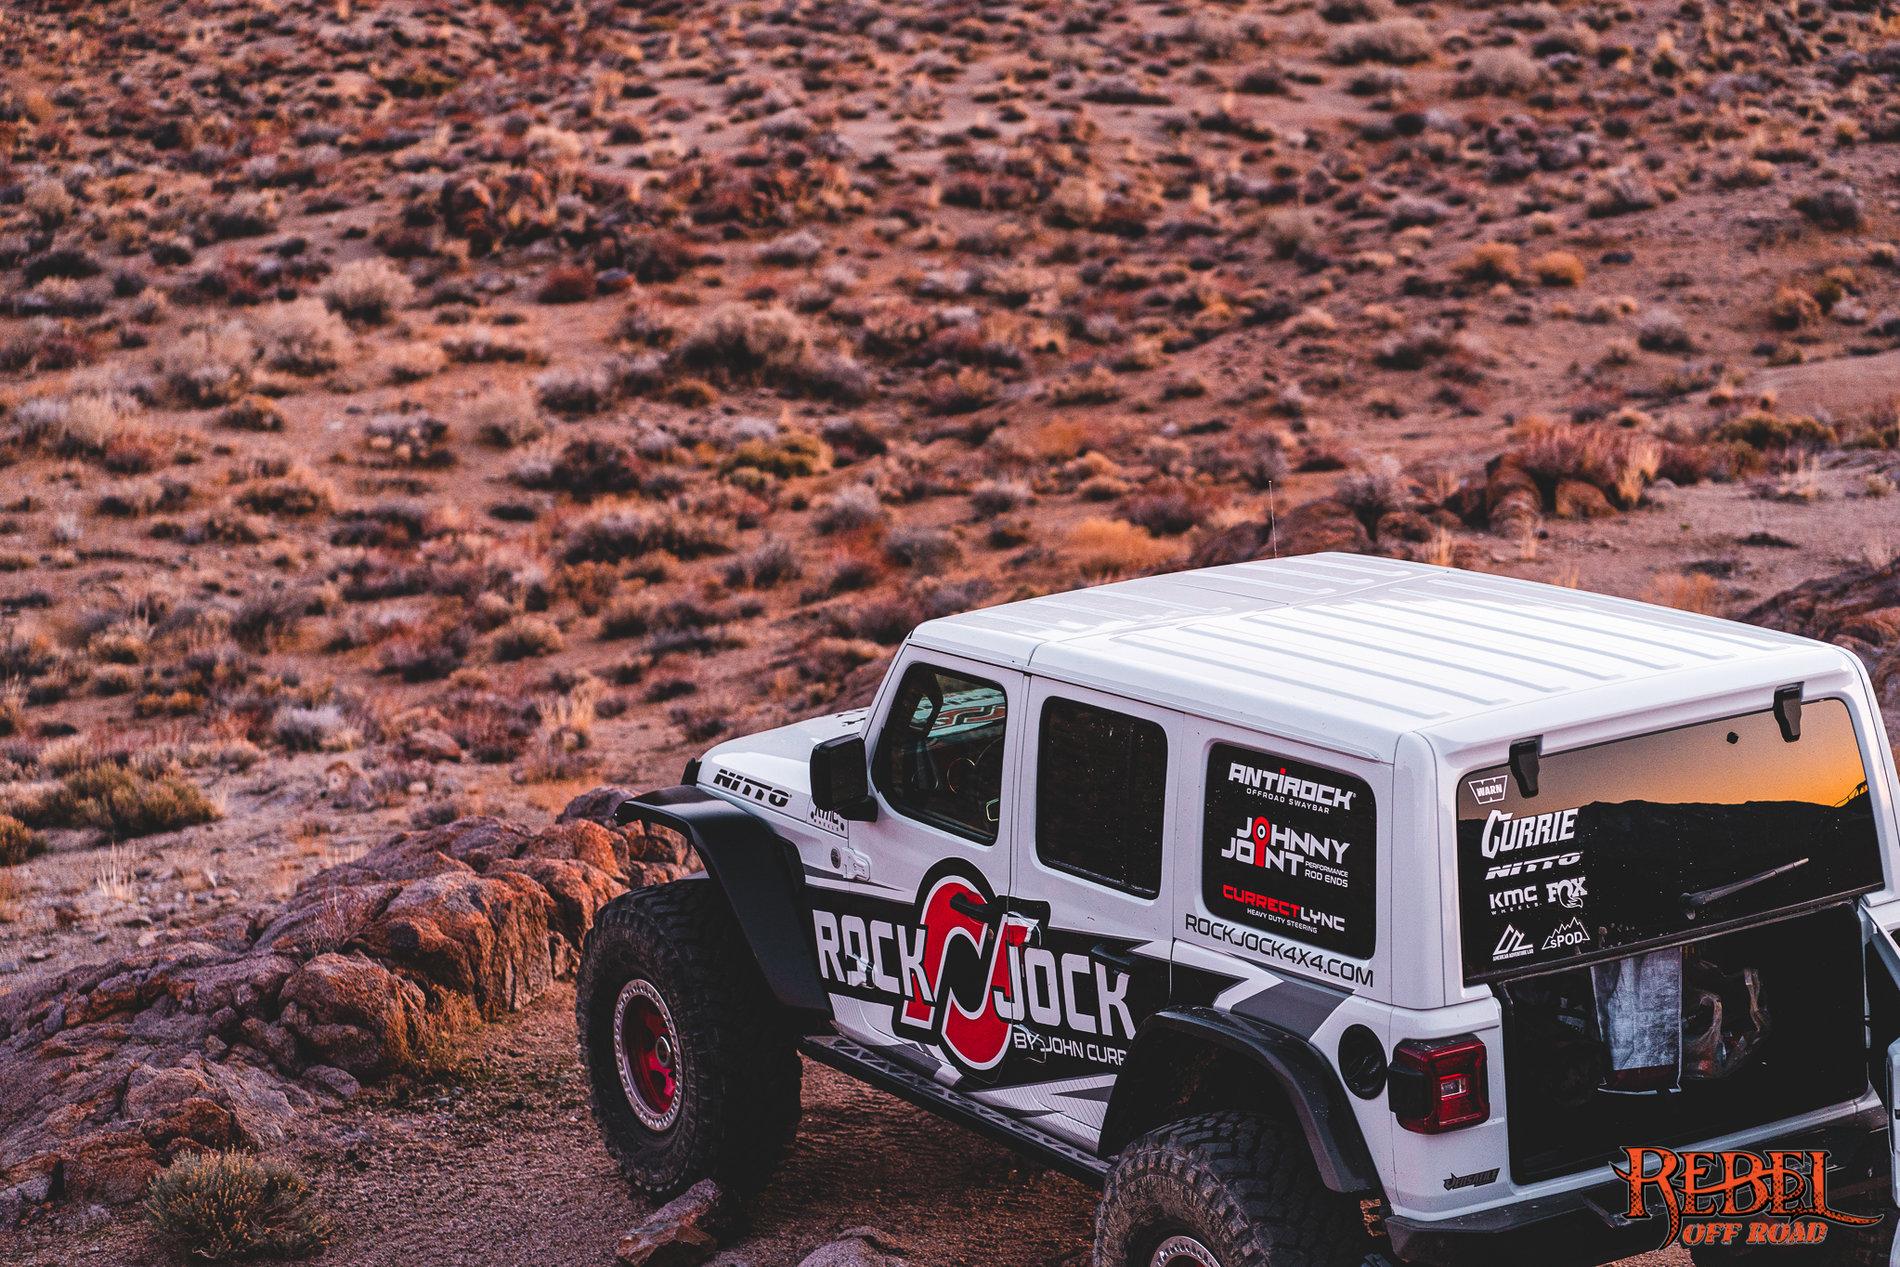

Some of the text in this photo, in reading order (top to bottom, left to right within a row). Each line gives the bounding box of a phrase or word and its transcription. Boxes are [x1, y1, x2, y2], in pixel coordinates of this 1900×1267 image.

[713, 768, 790, 808] NITTO
[1246, 788, 1330, 815] OFFROAD SWAYBAR
[1476, 782, 1503, 797] WARN
[1236, 816, 1350, 865] JOHNNY
[1481, 807, 1580, 860] CURRIE
[1221, 836, 1305, 876] JOINT
[1305, 860, 1349, 878] PERFORMANCE
[1485, 852, 1583, 881] NITTO
[1304, 869, 1349, 888] ROD ENDS
[1546, 876, 1588, 909] FOX
[1222, 884, 1345, 932] CURRECTLYNC
[1246, 908, 1318, 934] HEAVY DUTY STEERING
[812, 909, 936, 1003] ROCK
[1185, 913, 1374, 988] ROCKJOCK4X4.COM
[993, 944, 1137, 1040] JOCK
[1013, 1032, 1040, 1050] BY
[1040, 1036, 1084, 1059] JOHN
